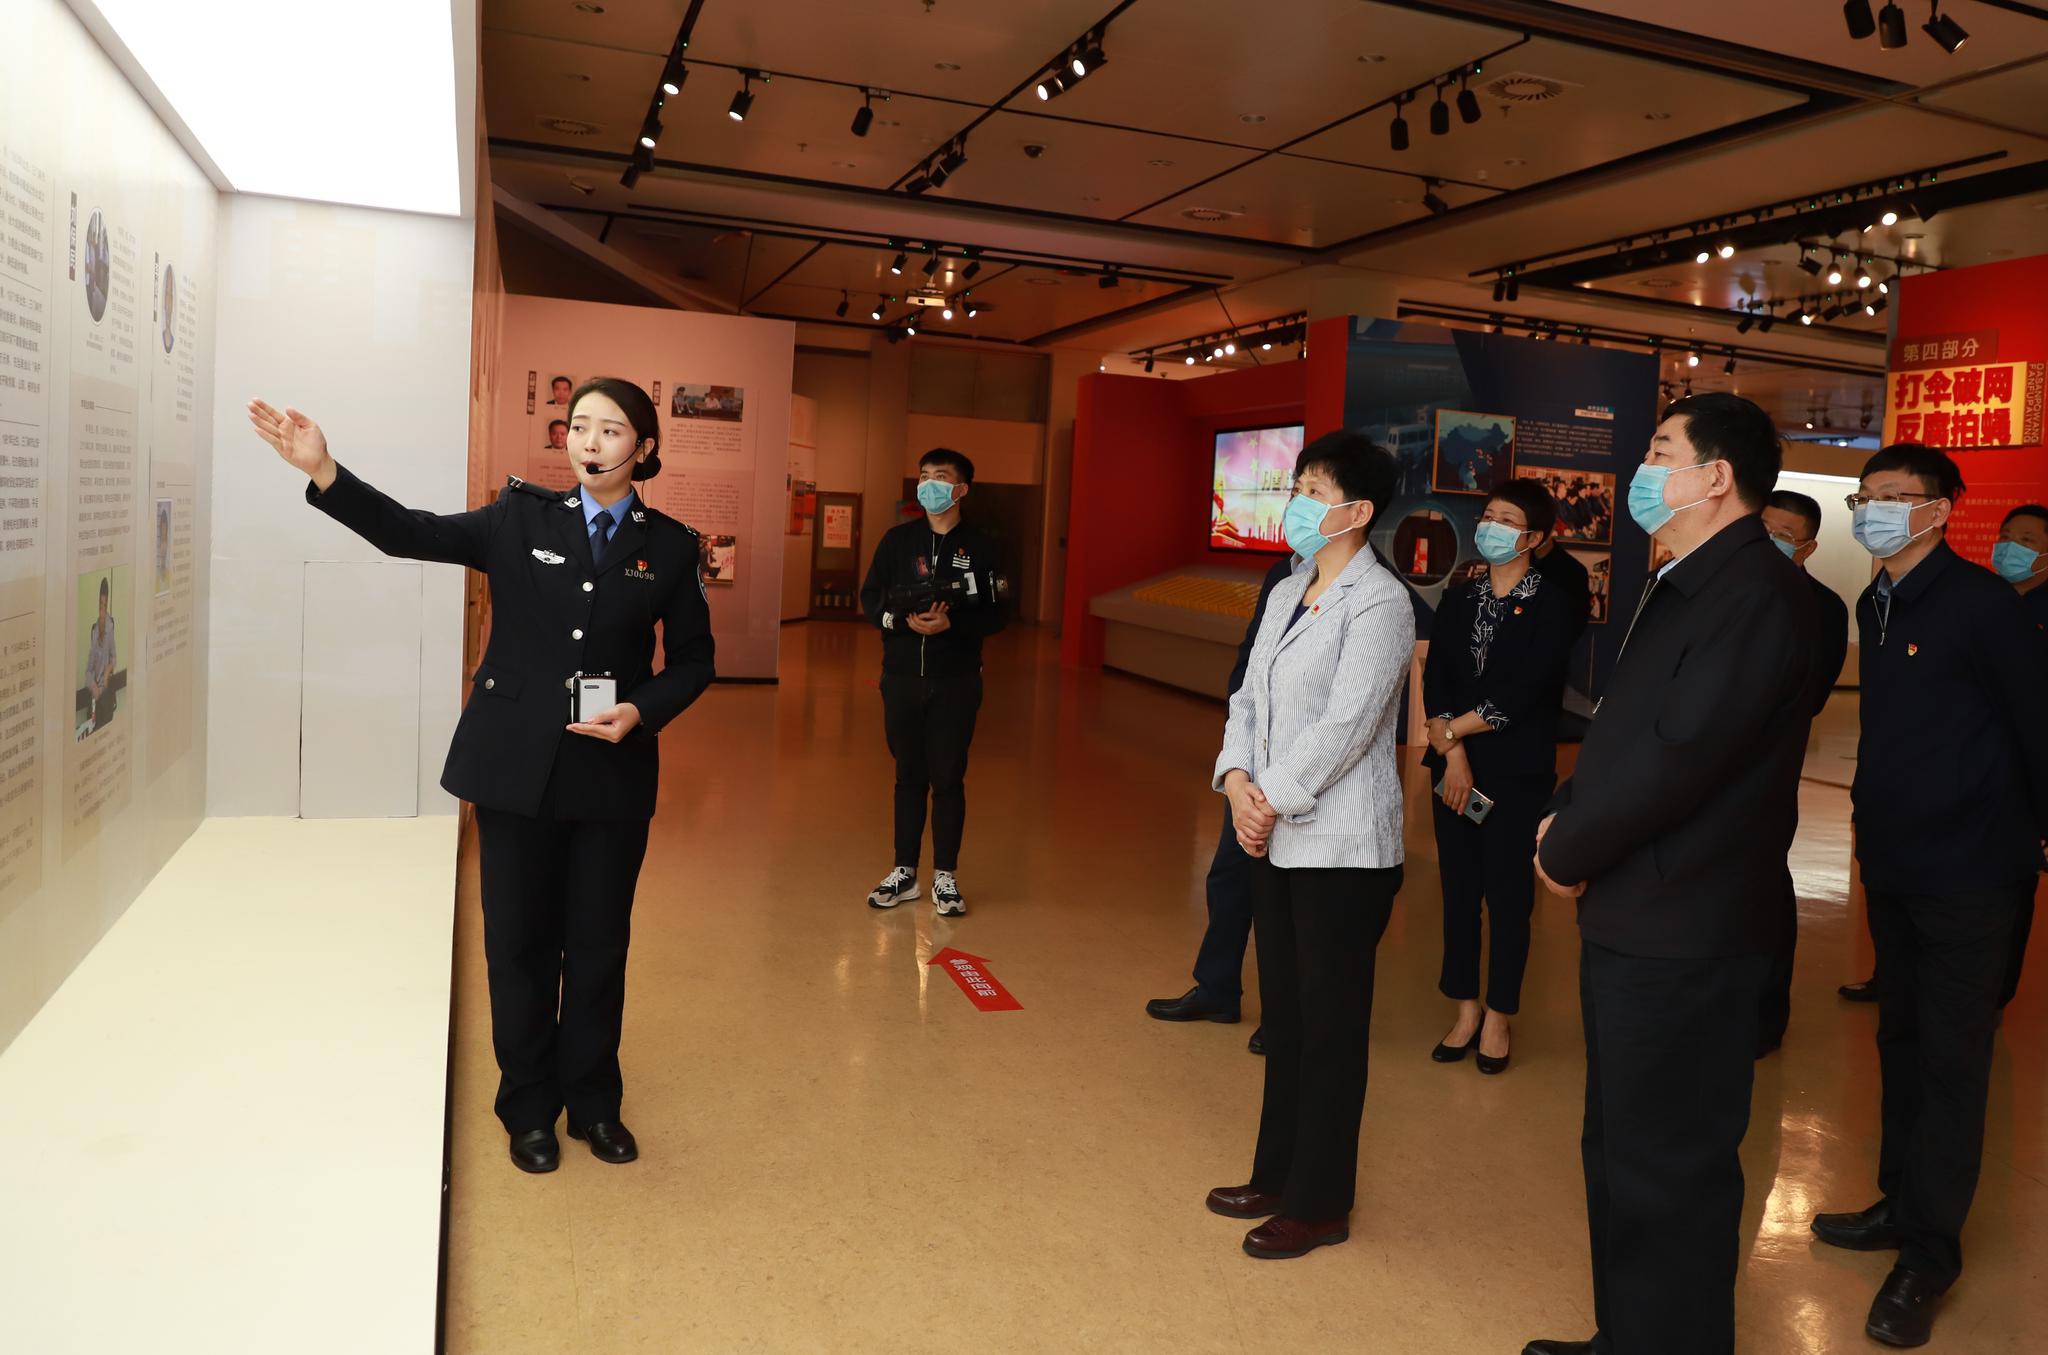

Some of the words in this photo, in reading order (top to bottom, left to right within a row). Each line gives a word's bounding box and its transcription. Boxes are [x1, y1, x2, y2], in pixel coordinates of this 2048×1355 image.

[1904, 338, 1979, 362] 第四部分
[1895, 366, 2014, 410] 打伞破网
[1893, 407, 2012, 447] 反腐拍蝇
